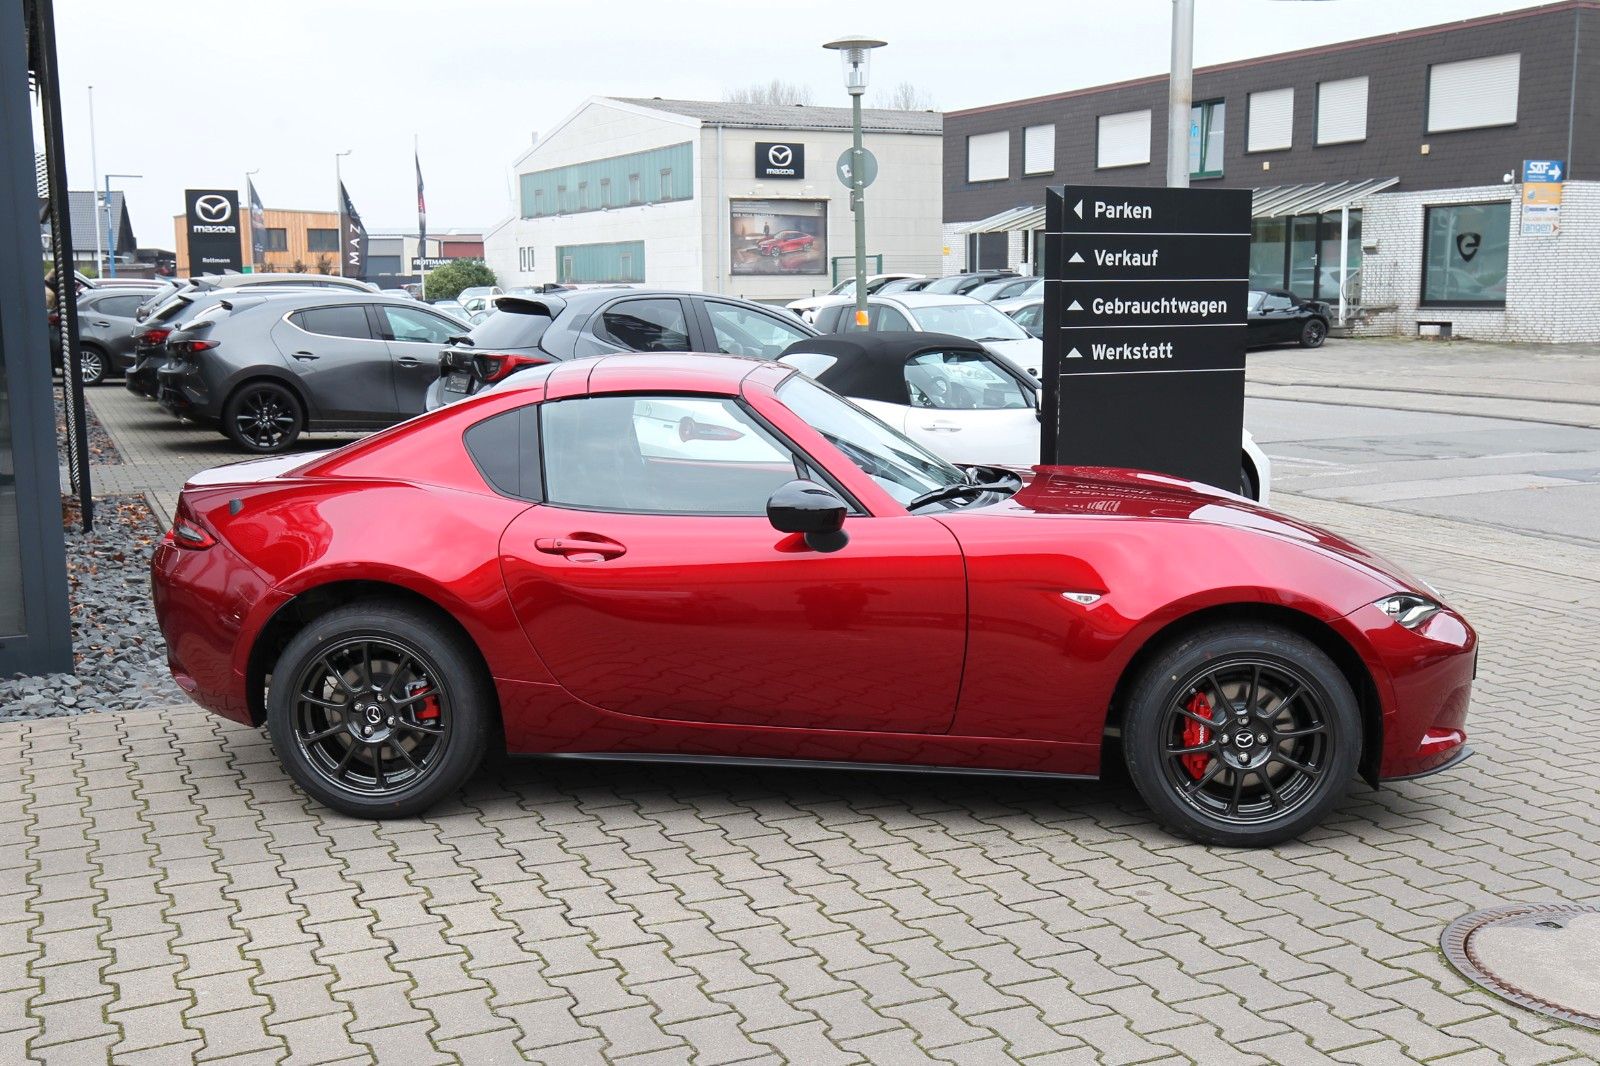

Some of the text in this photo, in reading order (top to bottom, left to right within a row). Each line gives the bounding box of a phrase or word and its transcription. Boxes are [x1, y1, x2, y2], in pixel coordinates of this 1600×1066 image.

[1094, 201, 1152, 219] Parken
[193, 225, 236, 233] mazda
[1094, 249, 1159, 266] Verkauf
[1092, 297, 1227, 317] Gebrauchtwagen
[1092, 342, 1173, 360] Werkstatt
